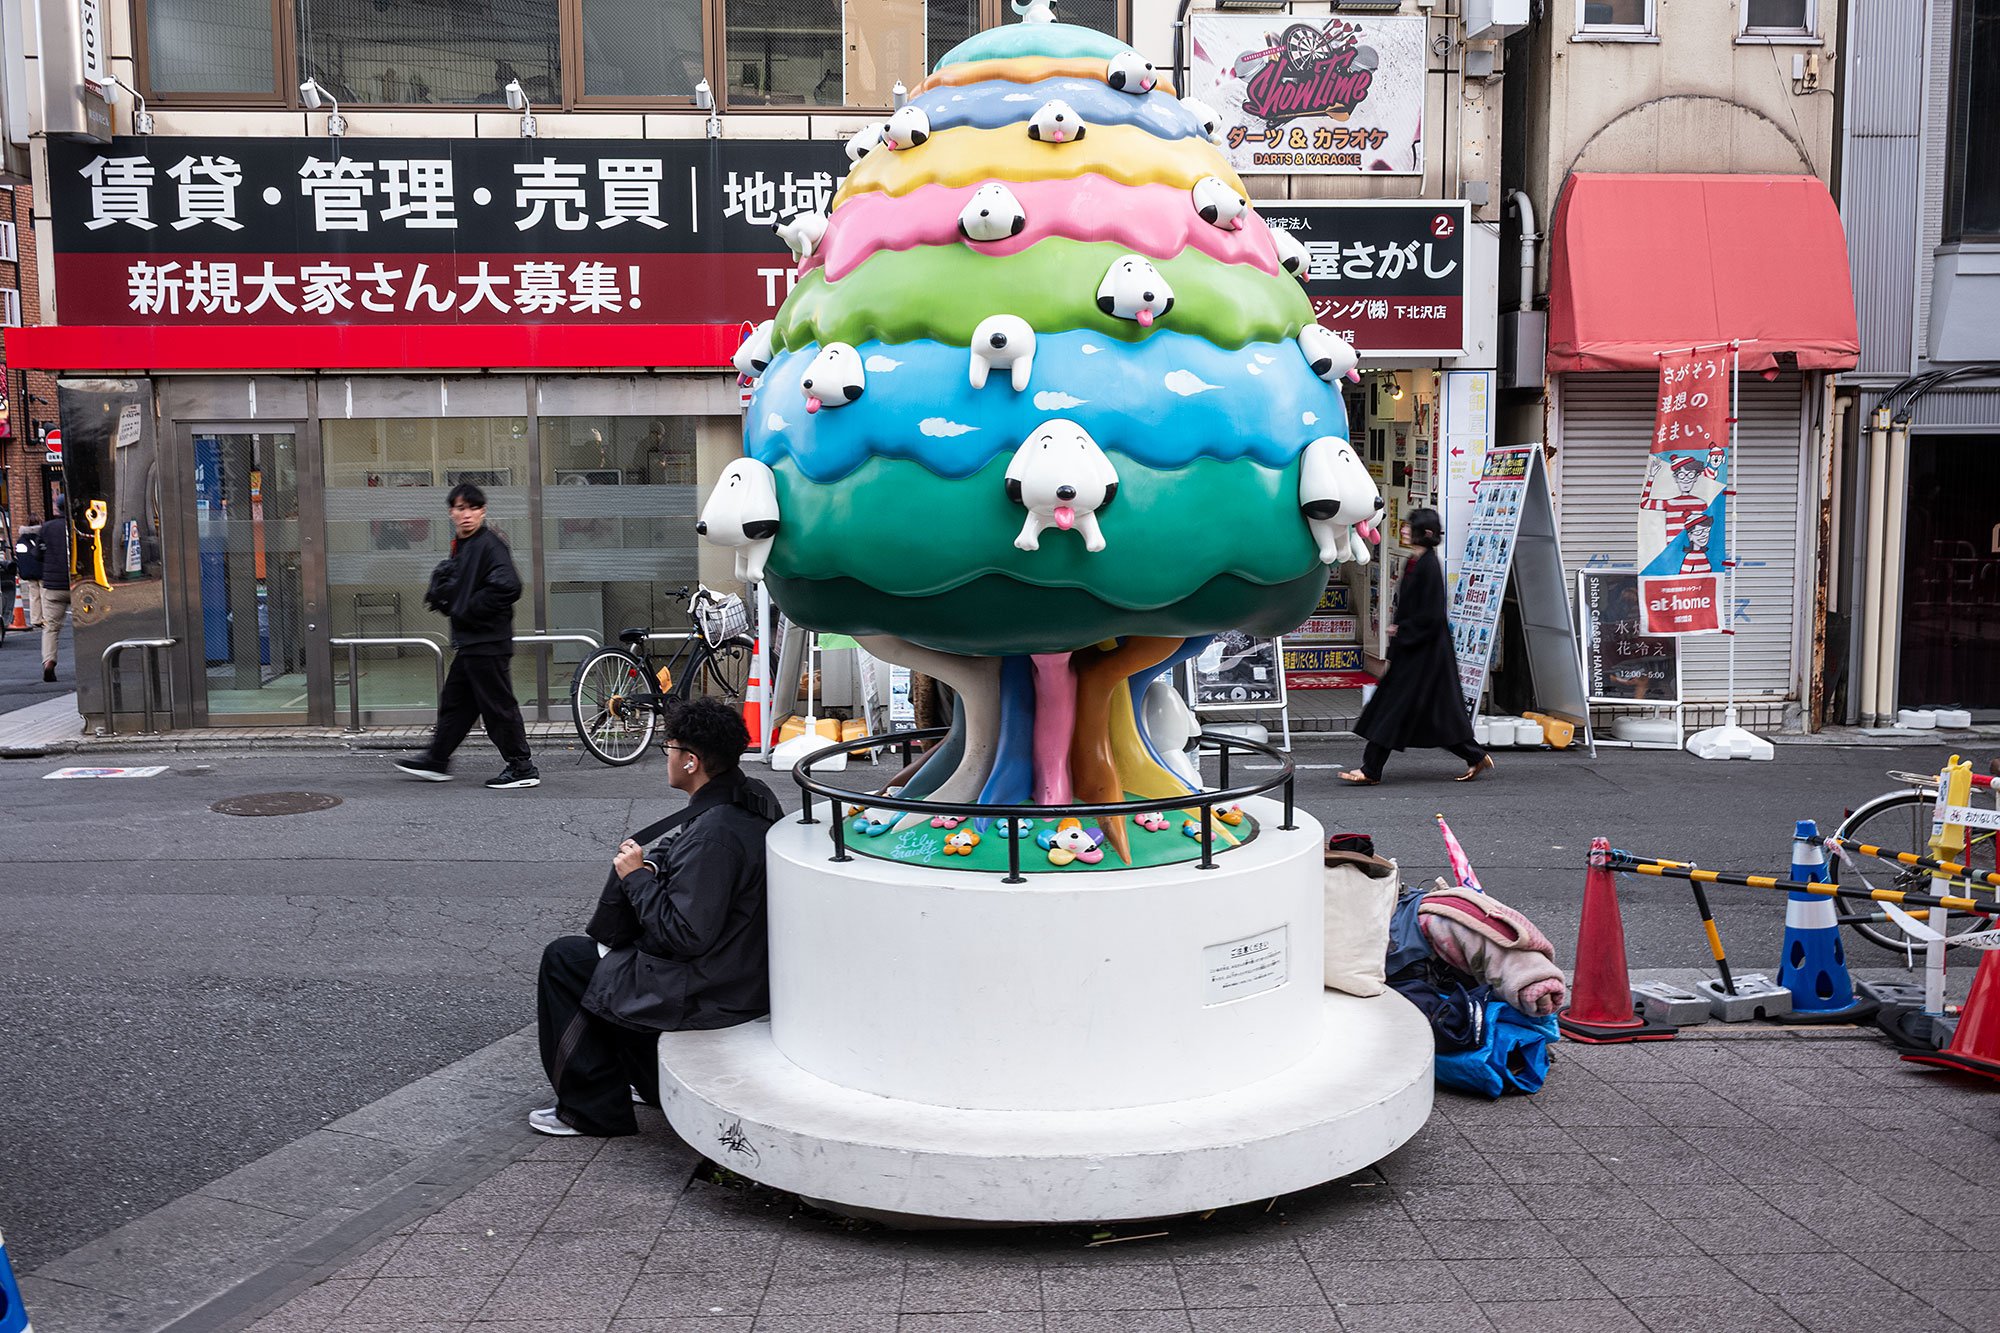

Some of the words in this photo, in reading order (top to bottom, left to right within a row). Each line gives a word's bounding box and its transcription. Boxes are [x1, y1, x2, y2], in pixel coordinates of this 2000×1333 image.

[1227, 126, 1284, 149] ダーツ
[1289, 127, 1307, 149] &
[1314, 126, 1388, 150] カラオケ
[1254, 153, 1292, 165] DARTS
[1294, 154, 1305, 165] &
[1306, 153, 1361, 165] KARAOKE
[79, 155, 669, 231] 賃貸・管理・売買
[723, 171, 846, 225] 地域
[1262, 217, 1312, 230] 指定法人
[1435, 216, 1454, 236] 2F
[1304, 240, 1457, 280] 屋さがし
[128, 260, 642, 315] 新規大家さん大募集！
[1394, 305, 1447, 319] 下北沢店
[1663, 358, 1725, 385] さがそう！
[1590, 577, 1599, 607] Shisha
[1650, 597, 1669, 611] at
[1671, 594, 1710, 611] home
[1591, 610, 1602, 655] Cafe&Bar
[1593, 655, 1604, 697] HANABIE
